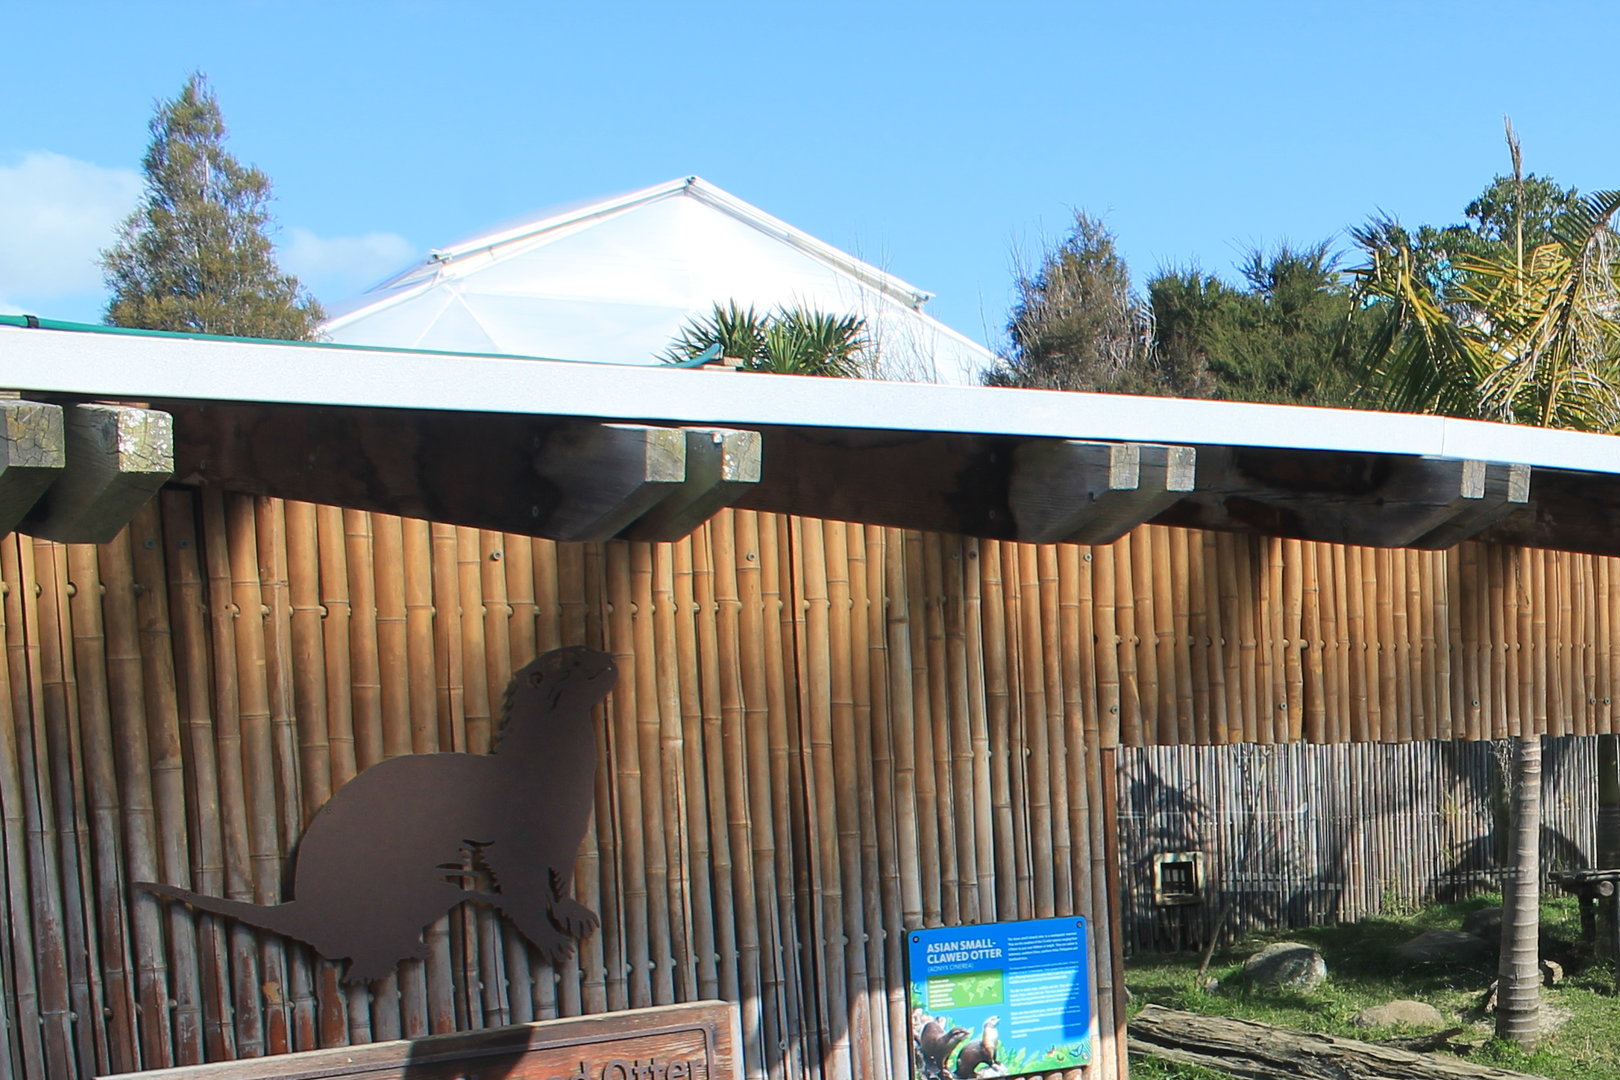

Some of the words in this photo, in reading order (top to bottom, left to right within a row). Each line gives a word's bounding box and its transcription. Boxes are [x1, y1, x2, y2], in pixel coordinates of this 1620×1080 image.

[927, 941, 958, 953] ASIAN
[960, 938, 996, 951] SMALL-
[926, 951, 969, 965] CLAWED
[971, 948, 1002, 959] OTTER
